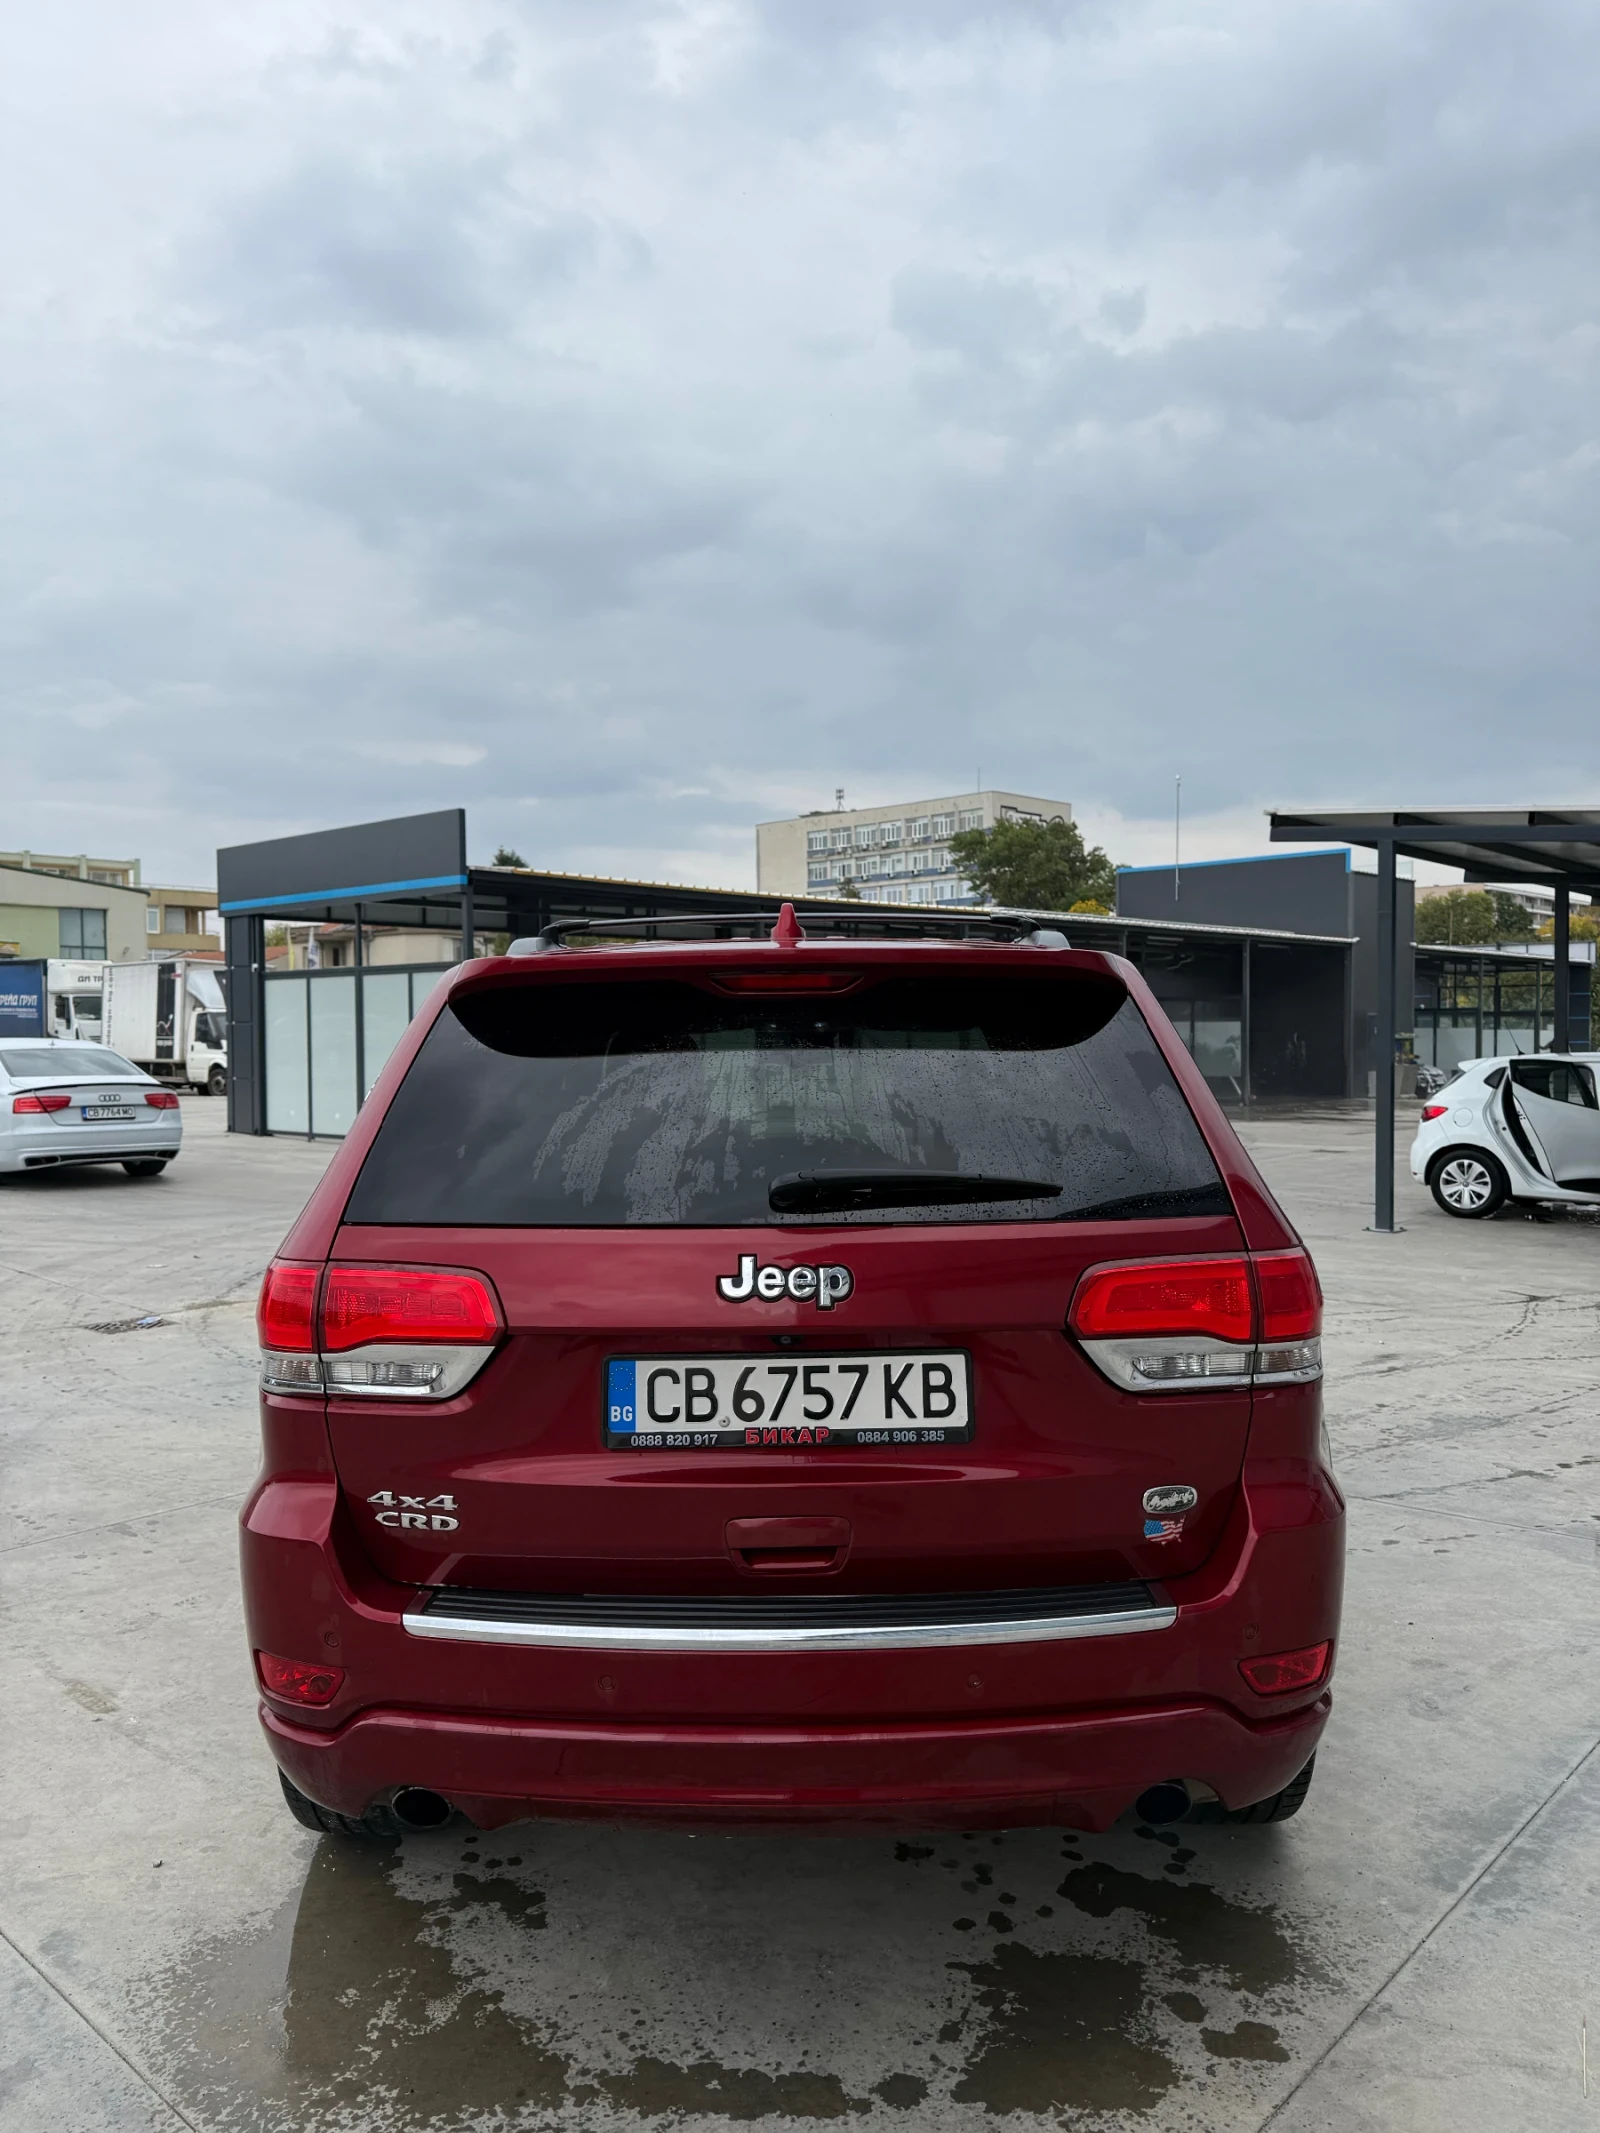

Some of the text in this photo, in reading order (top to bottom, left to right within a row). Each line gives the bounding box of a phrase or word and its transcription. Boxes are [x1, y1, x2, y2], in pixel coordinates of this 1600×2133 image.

[88, 1107, 99, 1117] CB
[718, 1255, 852, 1308] Jeep
[647, 1363, 957, 1423] CB 6757 KB
[610, 1406, 633, 1422] BG
[630, 1427, 945, 1447] 0888 820 917 БИКАР 0884 906 385
[366, 1490, 459, 1511] 4x4
[374, 1511, 460, 1531] CRD
